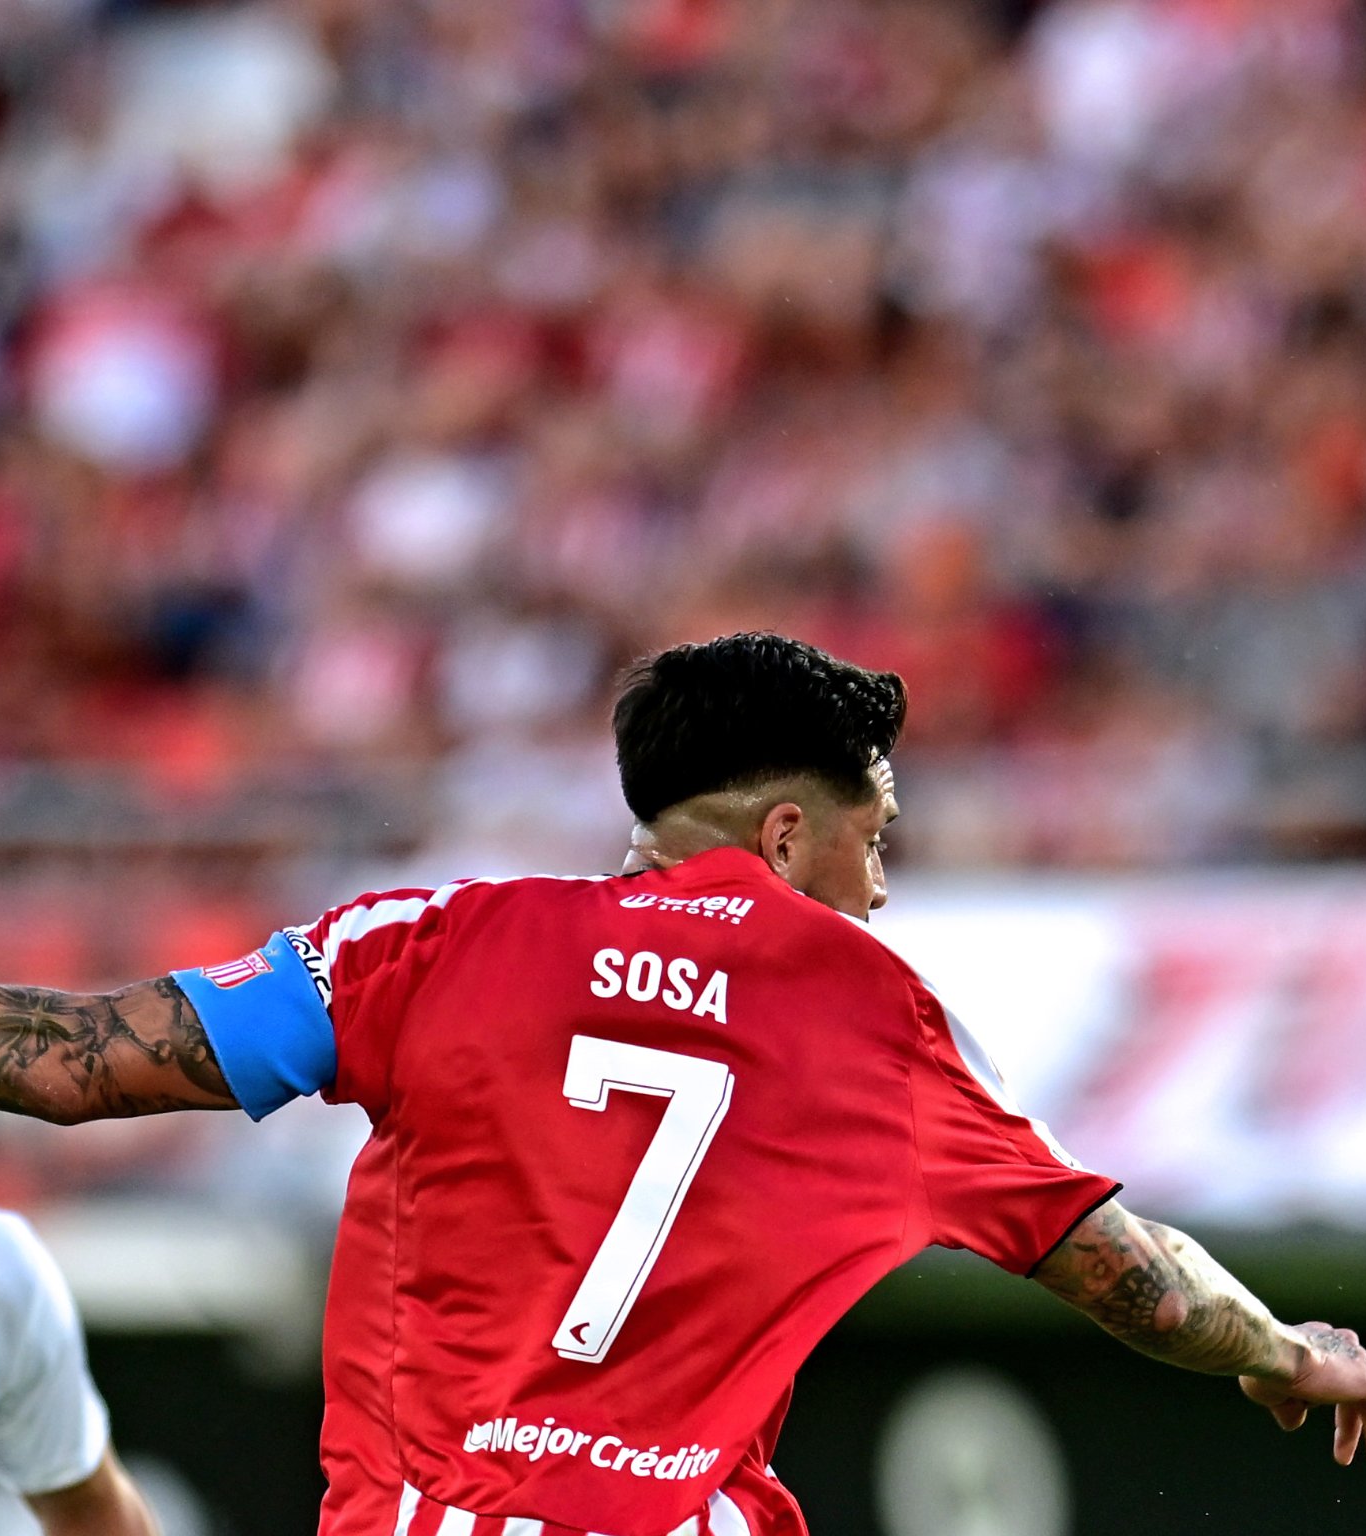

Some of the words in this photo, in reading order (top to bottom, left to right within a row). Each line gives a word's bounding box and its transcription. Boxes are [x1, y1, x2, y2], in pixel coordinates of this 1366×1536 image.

[657, 904, 742, 925] SPORTS
[590, 948, 729, 1024] SOSA
[552, 1034, 734, 1364] 7
[490, 1417, 592, 1462] Mejor
[589, 1435, 720, 1480] Crédito
